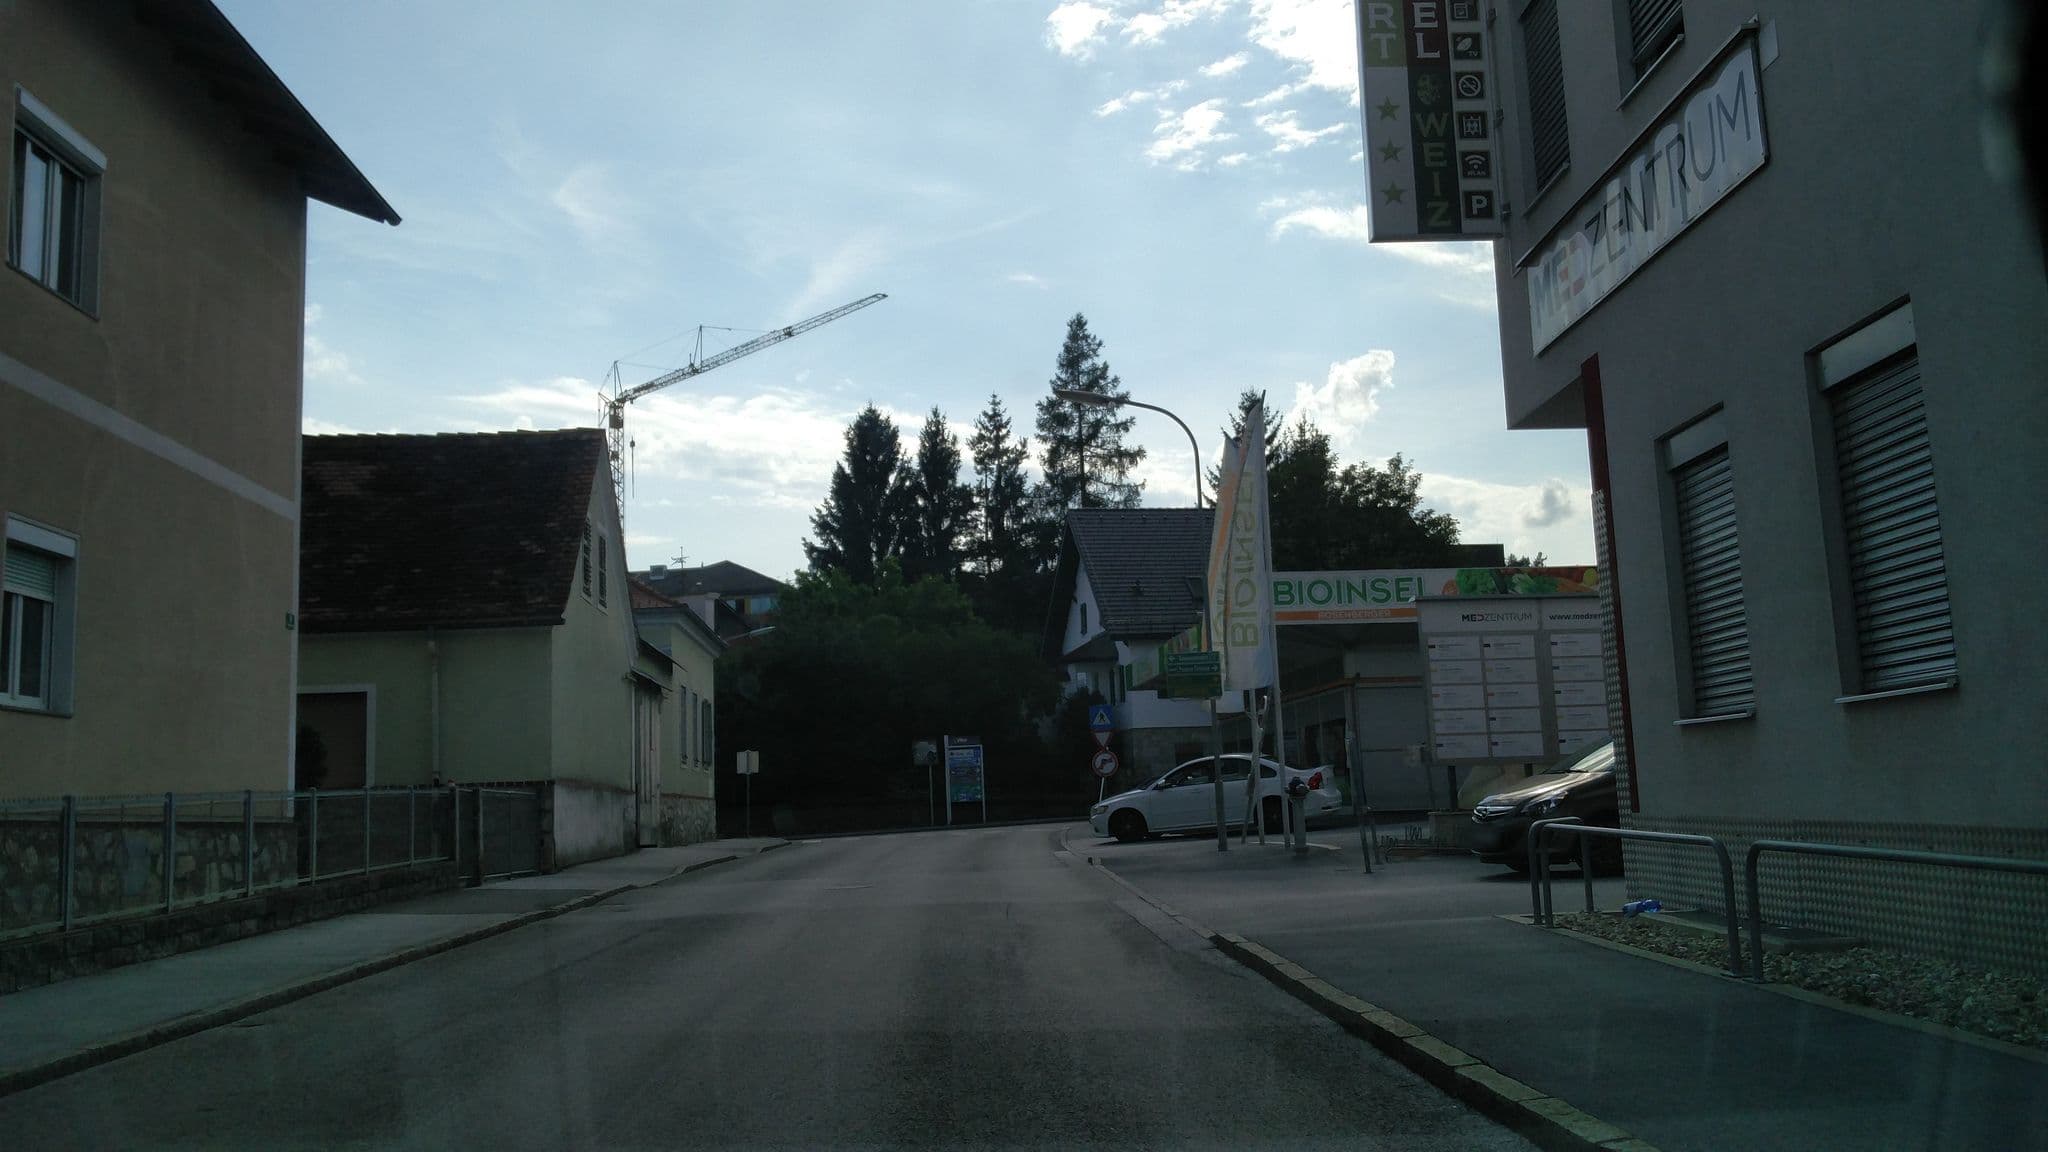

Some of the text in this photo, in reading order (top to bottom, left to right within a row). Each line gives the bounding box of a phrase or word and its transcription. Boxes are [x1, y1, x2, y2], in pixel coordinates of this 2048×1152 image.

[1415, 111, 1450, 228] WEIZ
[1532, 70, 1751, 331] MEDZENTRUM
[1471, 195, 1488, 215] P
[1461, 612, 1533, 622] MEDZENTRUM
